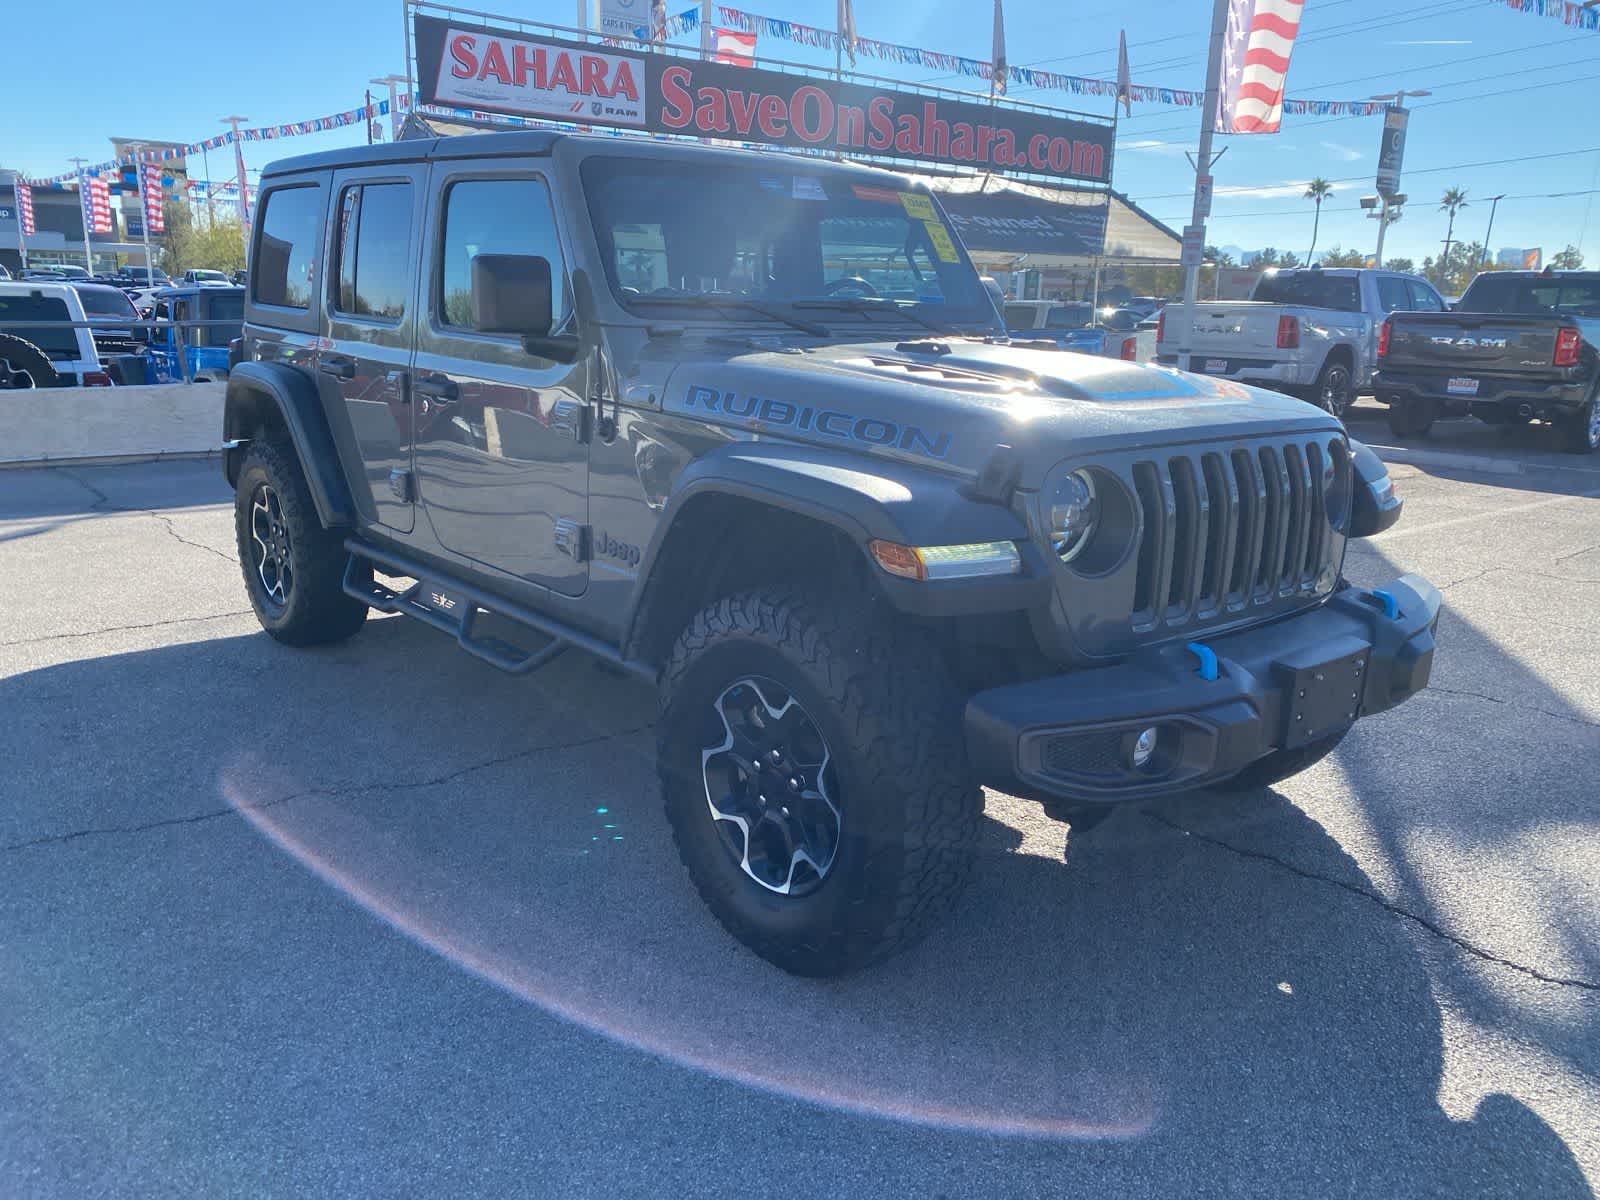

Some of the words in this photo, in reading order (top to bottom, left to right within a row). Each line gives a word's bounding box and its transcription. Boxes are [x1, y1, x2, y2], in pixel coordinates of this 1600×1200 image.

[450, 35, 640, 101] SAHARA
[605, 107, 639, 117] RAM
[660, 65, 1105, 177] SaveOnSahara.com
[1431, 336, 1507, 348] RAM
[684, 383, 952, 458] RUBICON
[598, 531, 641, 568] Jeep
